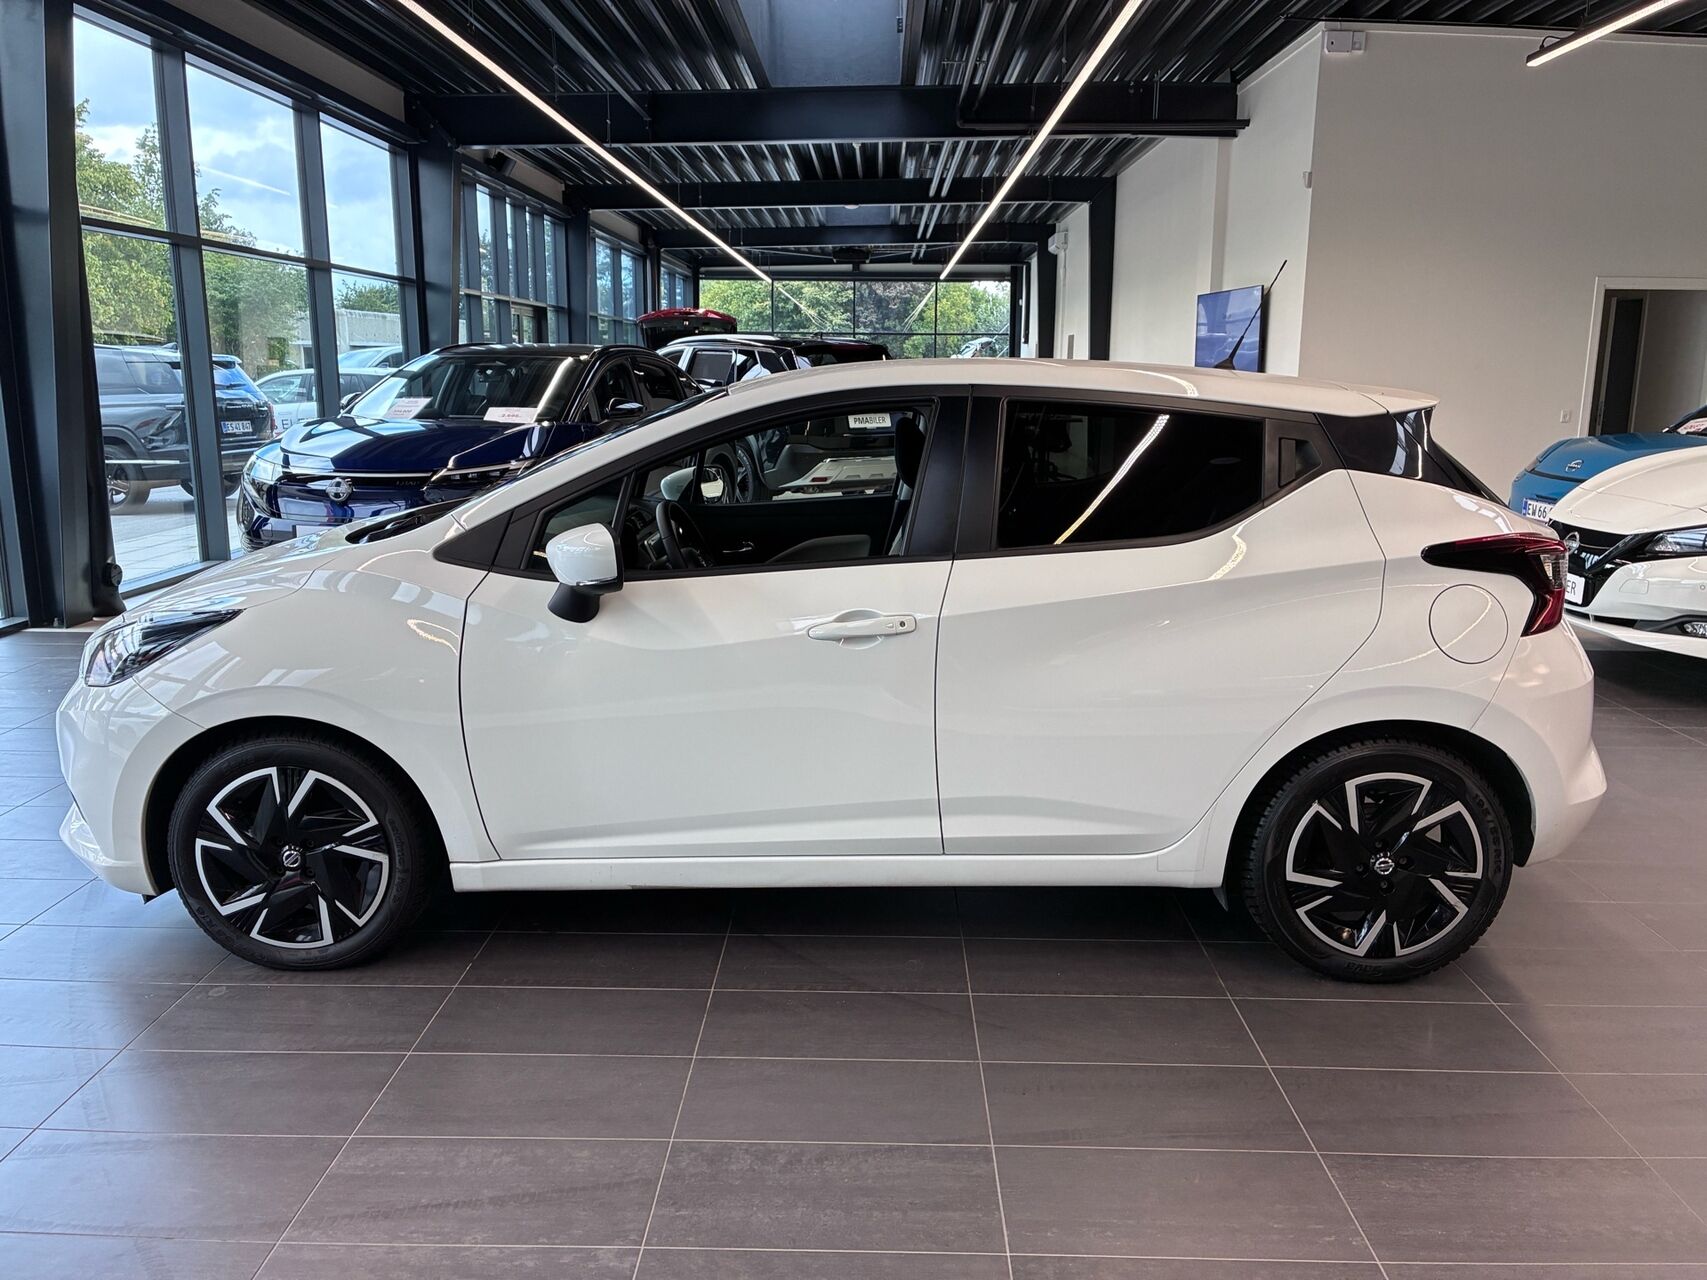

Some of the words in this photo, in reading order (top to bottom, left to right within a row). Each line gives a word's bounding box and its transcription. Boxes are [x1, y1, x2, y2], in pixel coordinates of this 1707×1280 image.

[853, 416, 887, 425] PMABILER
[1527, 503, 1538, 517] EW
[1538, 505, 1547, 519] 66
